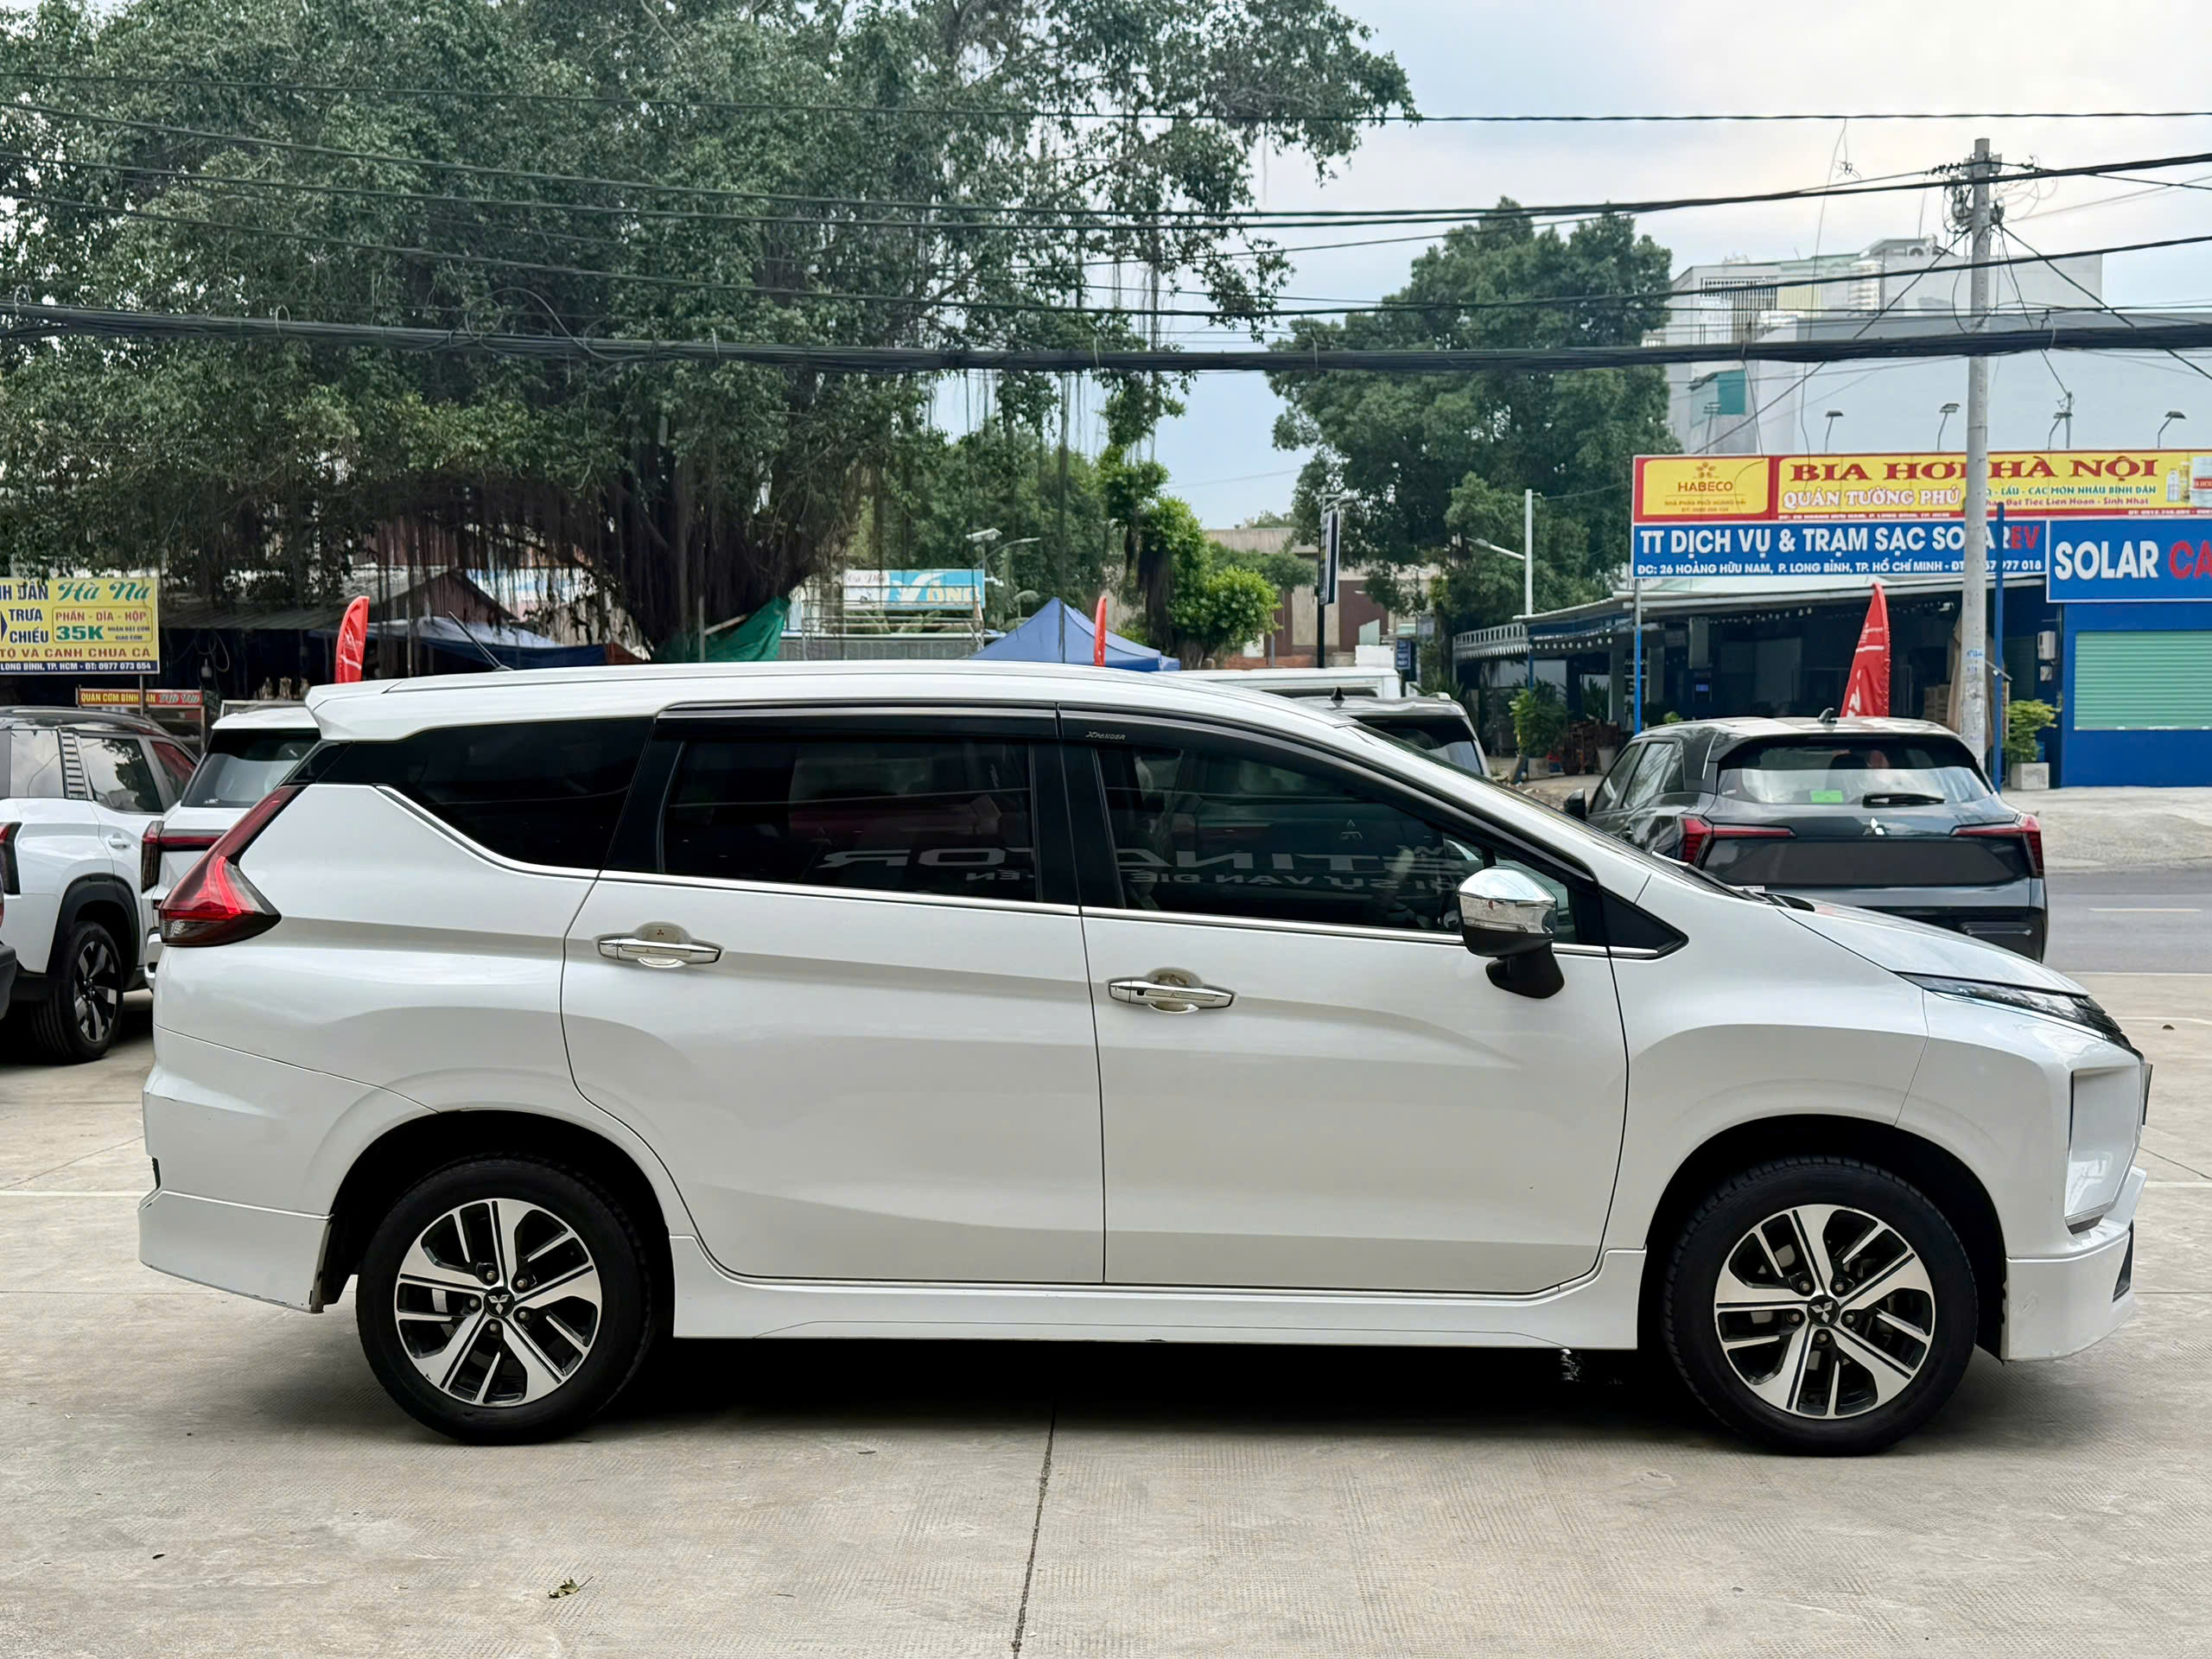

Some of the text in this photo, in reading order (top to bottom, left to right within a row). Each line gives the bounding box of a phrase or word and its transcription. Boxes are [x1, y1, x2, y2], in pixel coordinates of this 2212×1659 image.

[1789, 463, 1872, 481] BIA
[1987, 455, 2059, 479] HÀ
[2069, 455, 2158, 481] NỘI
[1678, 481, 1733, 492] HABECO
[1783, 484, 1960, 510] QUÁN TƯỜNG PHÚ
[1640, 530, 1665, 554] TT
[1670, 529, 1731, 560] DỊCH
[1738, 528, 1770, 559] VỤ
[1778, 528, 1796, 553] &
[1802, 527, 1868, 558] TRẠM
[1874, 526, 1926, 557] SẠC
[1637, 564, 1657, 575] ĐC:
[1660, 564, 1674, 575] 26
[1675, 560, 1717, 575] HOÀNG
[1719, 561, 1742, 574] HỮU
[1745, 563, 1773, 575] NAM,
[1778, 563, 1788, 573] P.
[1790, 562, 1821, 573] LONG
[1855, 562, 1870, 572] TP.
[1872, 557, 1890, 572] HỒ
[1892, 558, 1913, 572] CHÍ
[1913, 560, 1942, 571] MINH
[2021, 560, 2042, 570] 018
[2054, 540, 2159, 581] SOLAR
[58, 581, 100, 602] Hà
[109, 581, 151, 602] Na
[9, 607, 42, 622] TRƯA
[124, 610, 146, 621] HỘP
[56, 626, 104, 640] 35K
[22, 647, 39, 658] VÀ
[45, 648, 83, 658] CANH
[88, 647, 127, 658] CHUA
